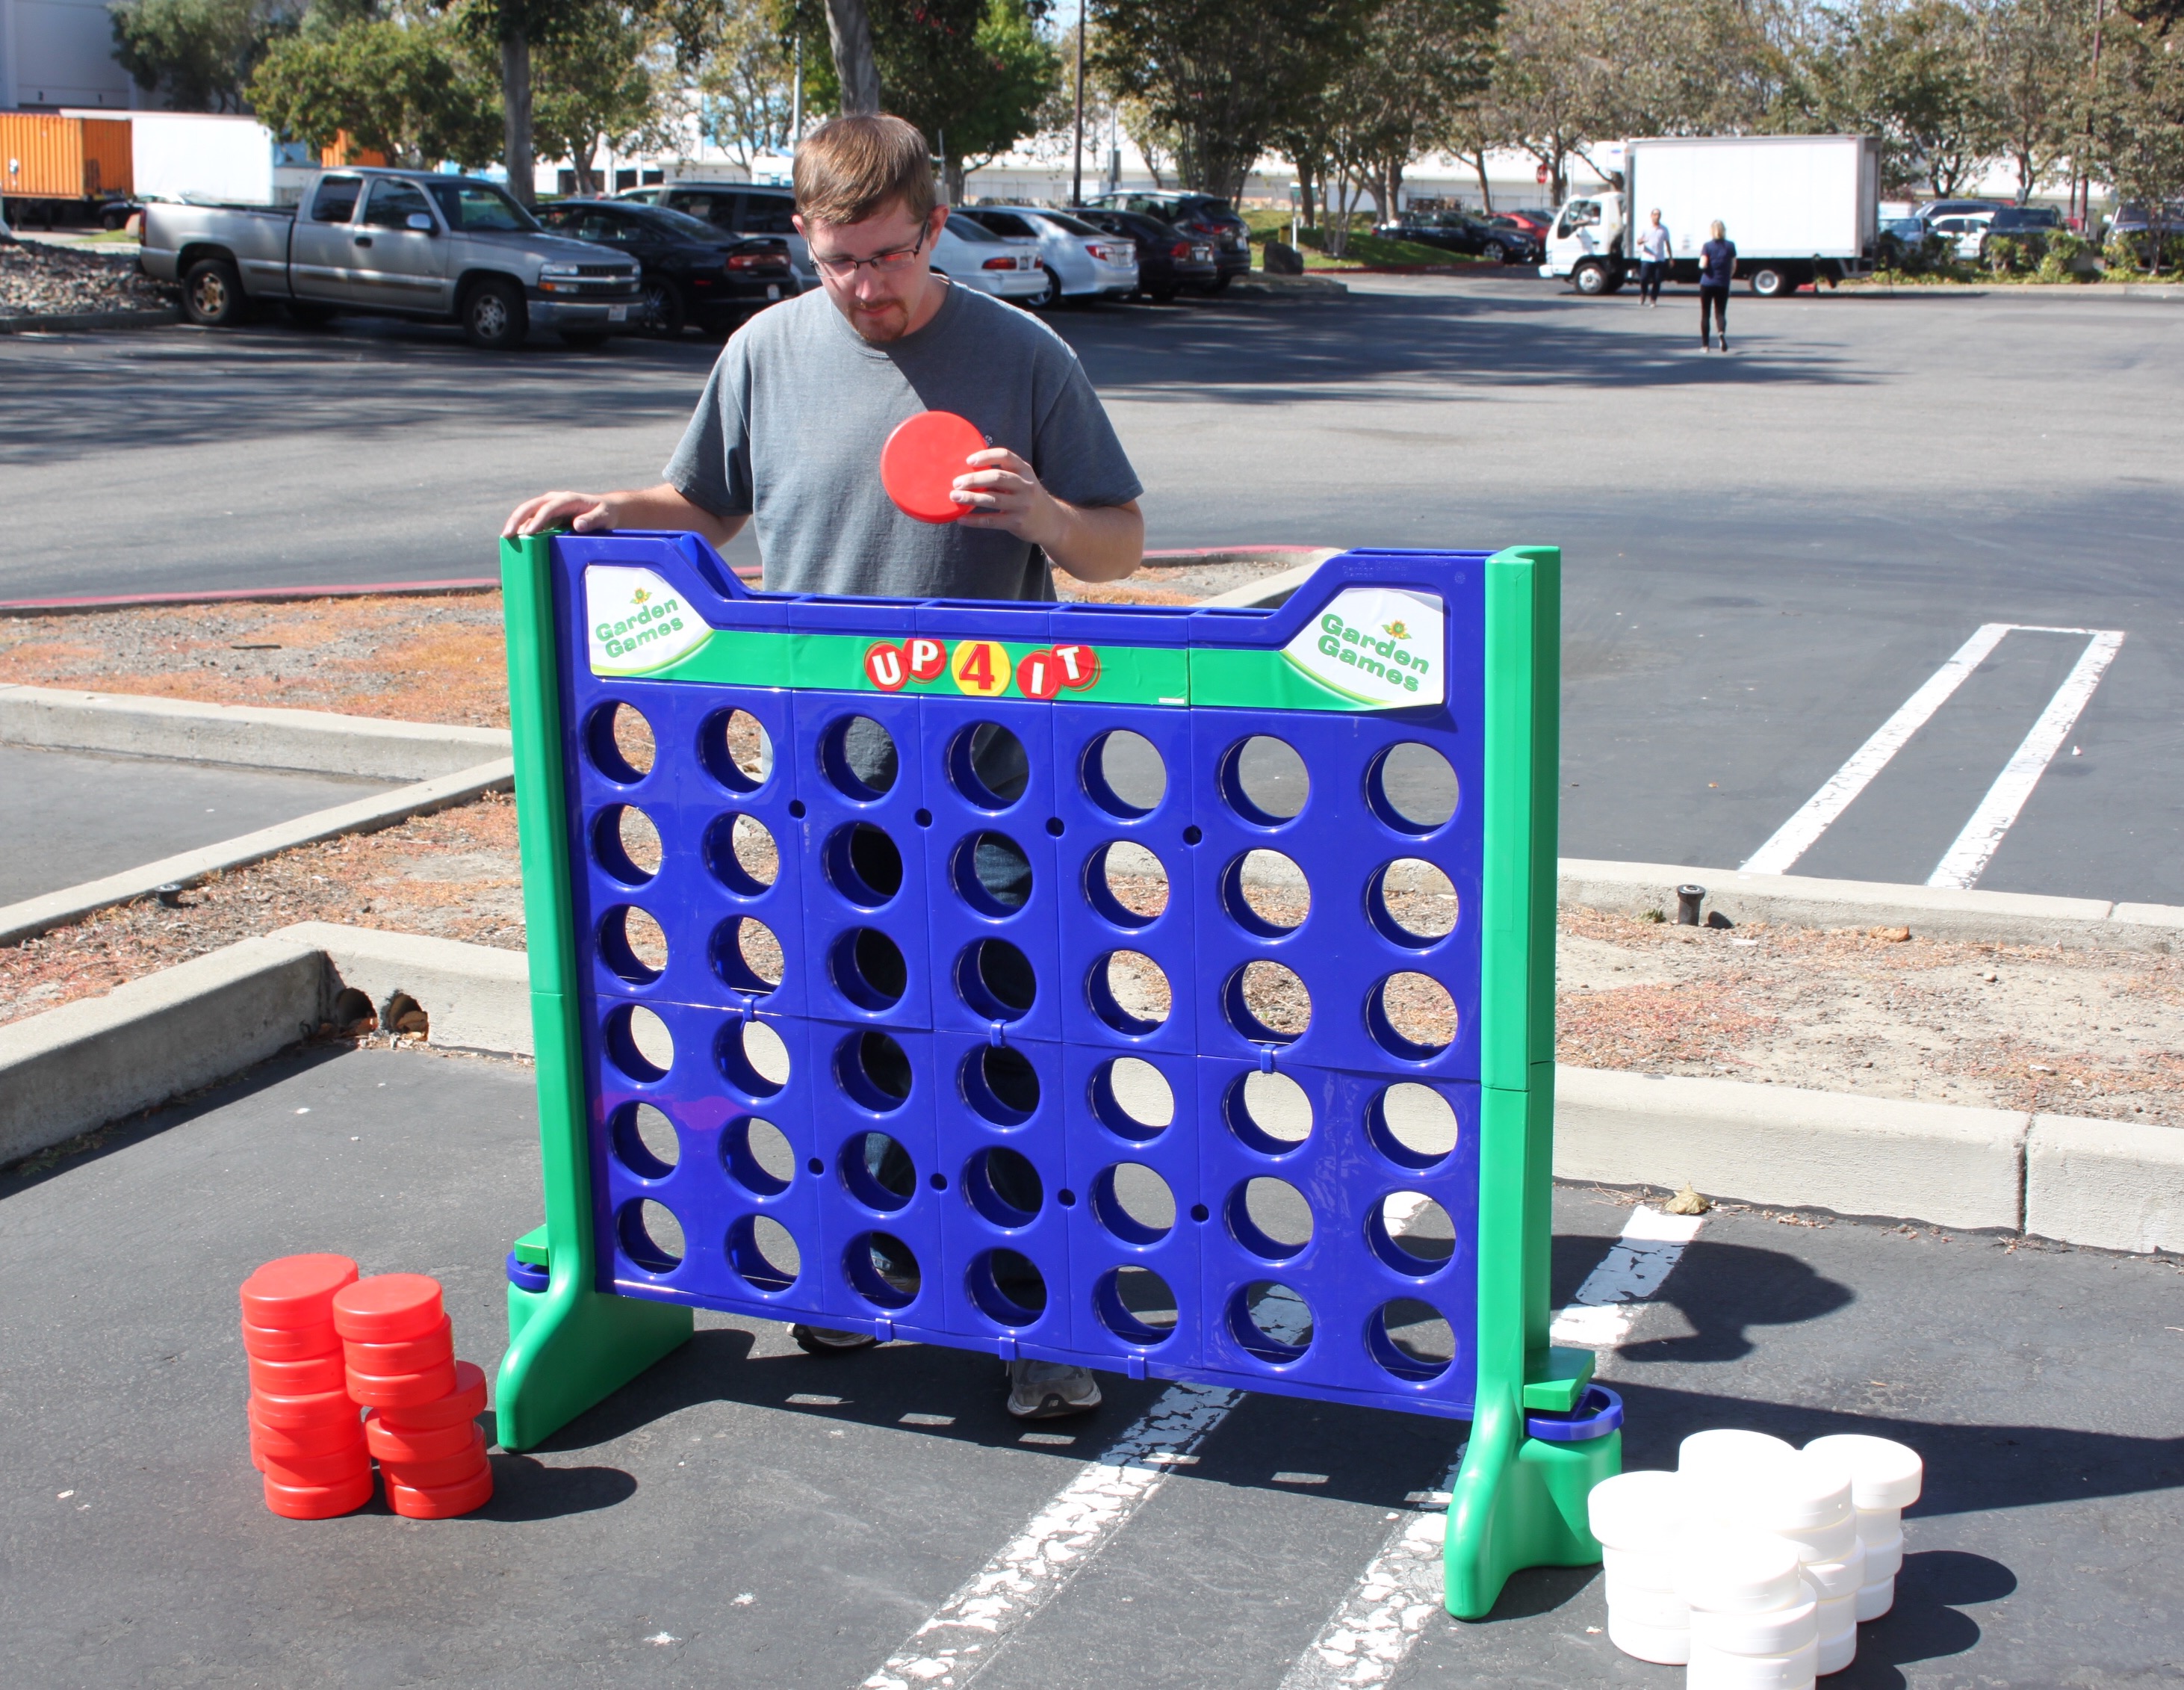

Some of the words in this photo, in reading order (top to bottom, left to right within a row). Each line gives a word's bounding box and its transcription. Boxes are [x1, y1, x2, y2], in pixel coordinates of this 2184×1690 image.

[596, 599, 678, 641] Garden
[606, 618, 683, 657] Games
[1321, 614, 1429, 674] Garden
[872, 640, 939, 685] UP
[959, 644, 994, 690] 4
[1031, 646, 1079, 695] IT
[1318, 635, 1418, 692] Games
